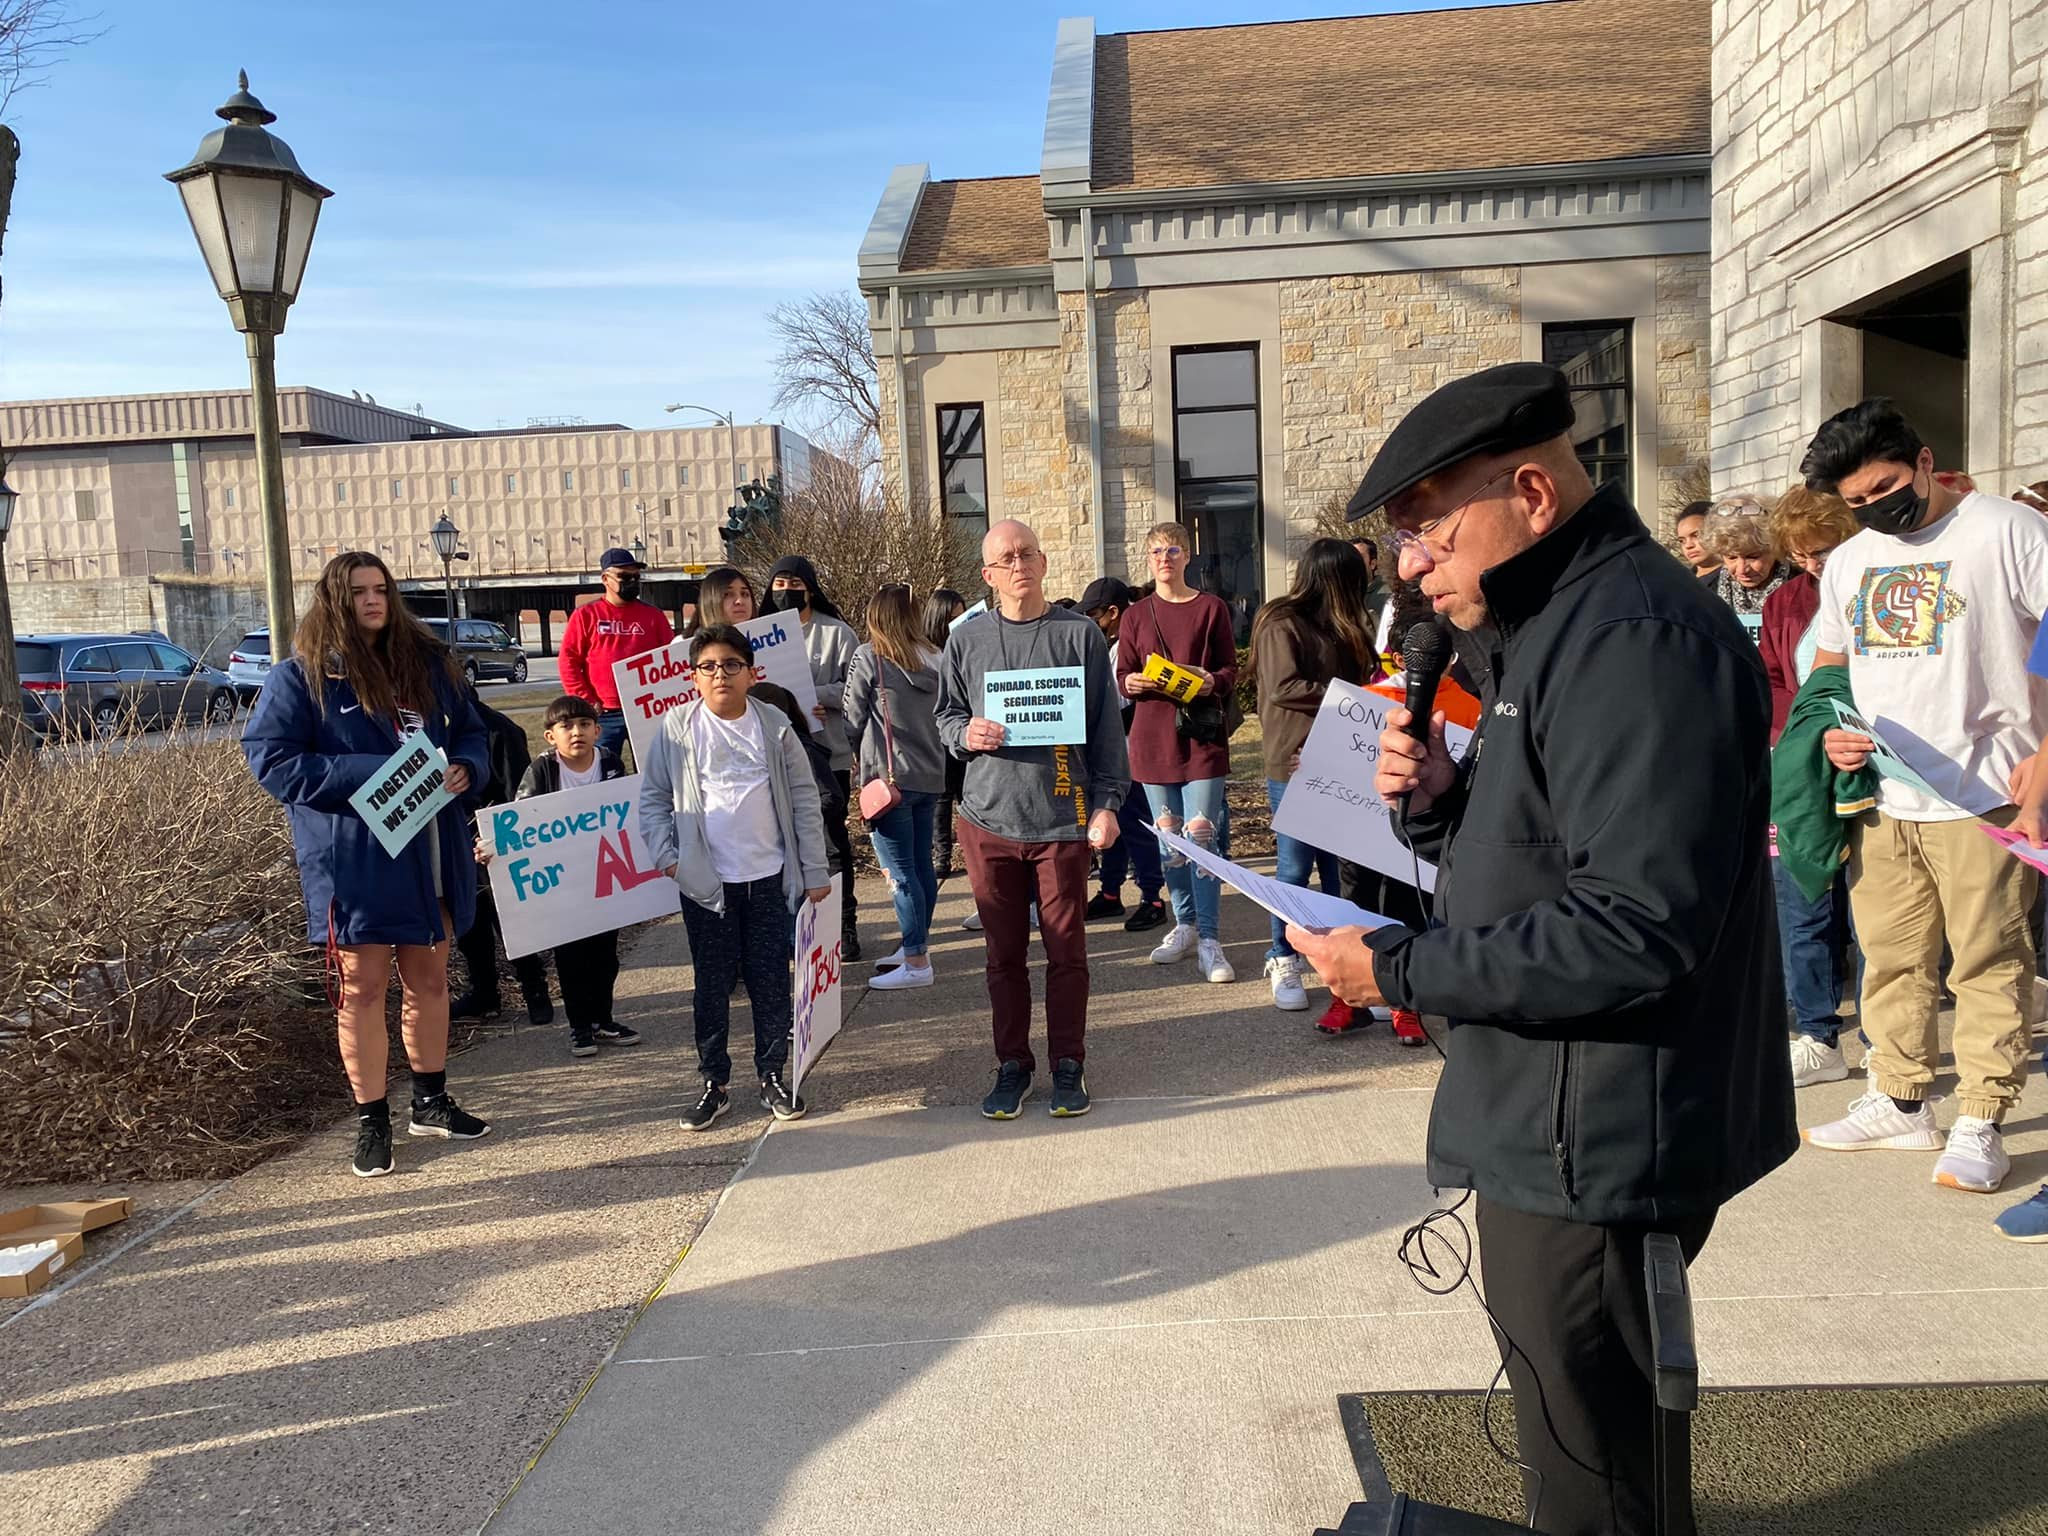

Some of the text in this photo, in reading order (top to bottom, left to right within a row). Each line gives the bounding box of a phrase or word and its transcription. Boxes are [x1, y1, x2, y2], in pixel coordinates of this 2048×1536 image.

[597, 619, 645, 635] FILA
[1876, 650, 1920, 660] ARIZONA
[986, 677, 1082, 693] CONDADO, ESCUCHA,
[1003, 694, 1065, 708] SEGUIREMOS
[1005, 711, 1063, 723] EN LA LUCHA
[366, 747, 430, 811] TOGETHER
[382, 807, 408, 833] WE
[403, 768, 444, 813] STAND
[1074, 785, 1087, 827] RUNNER
[493, 800, 631, 856] Recovery
[508, 857, 565, 902] For
